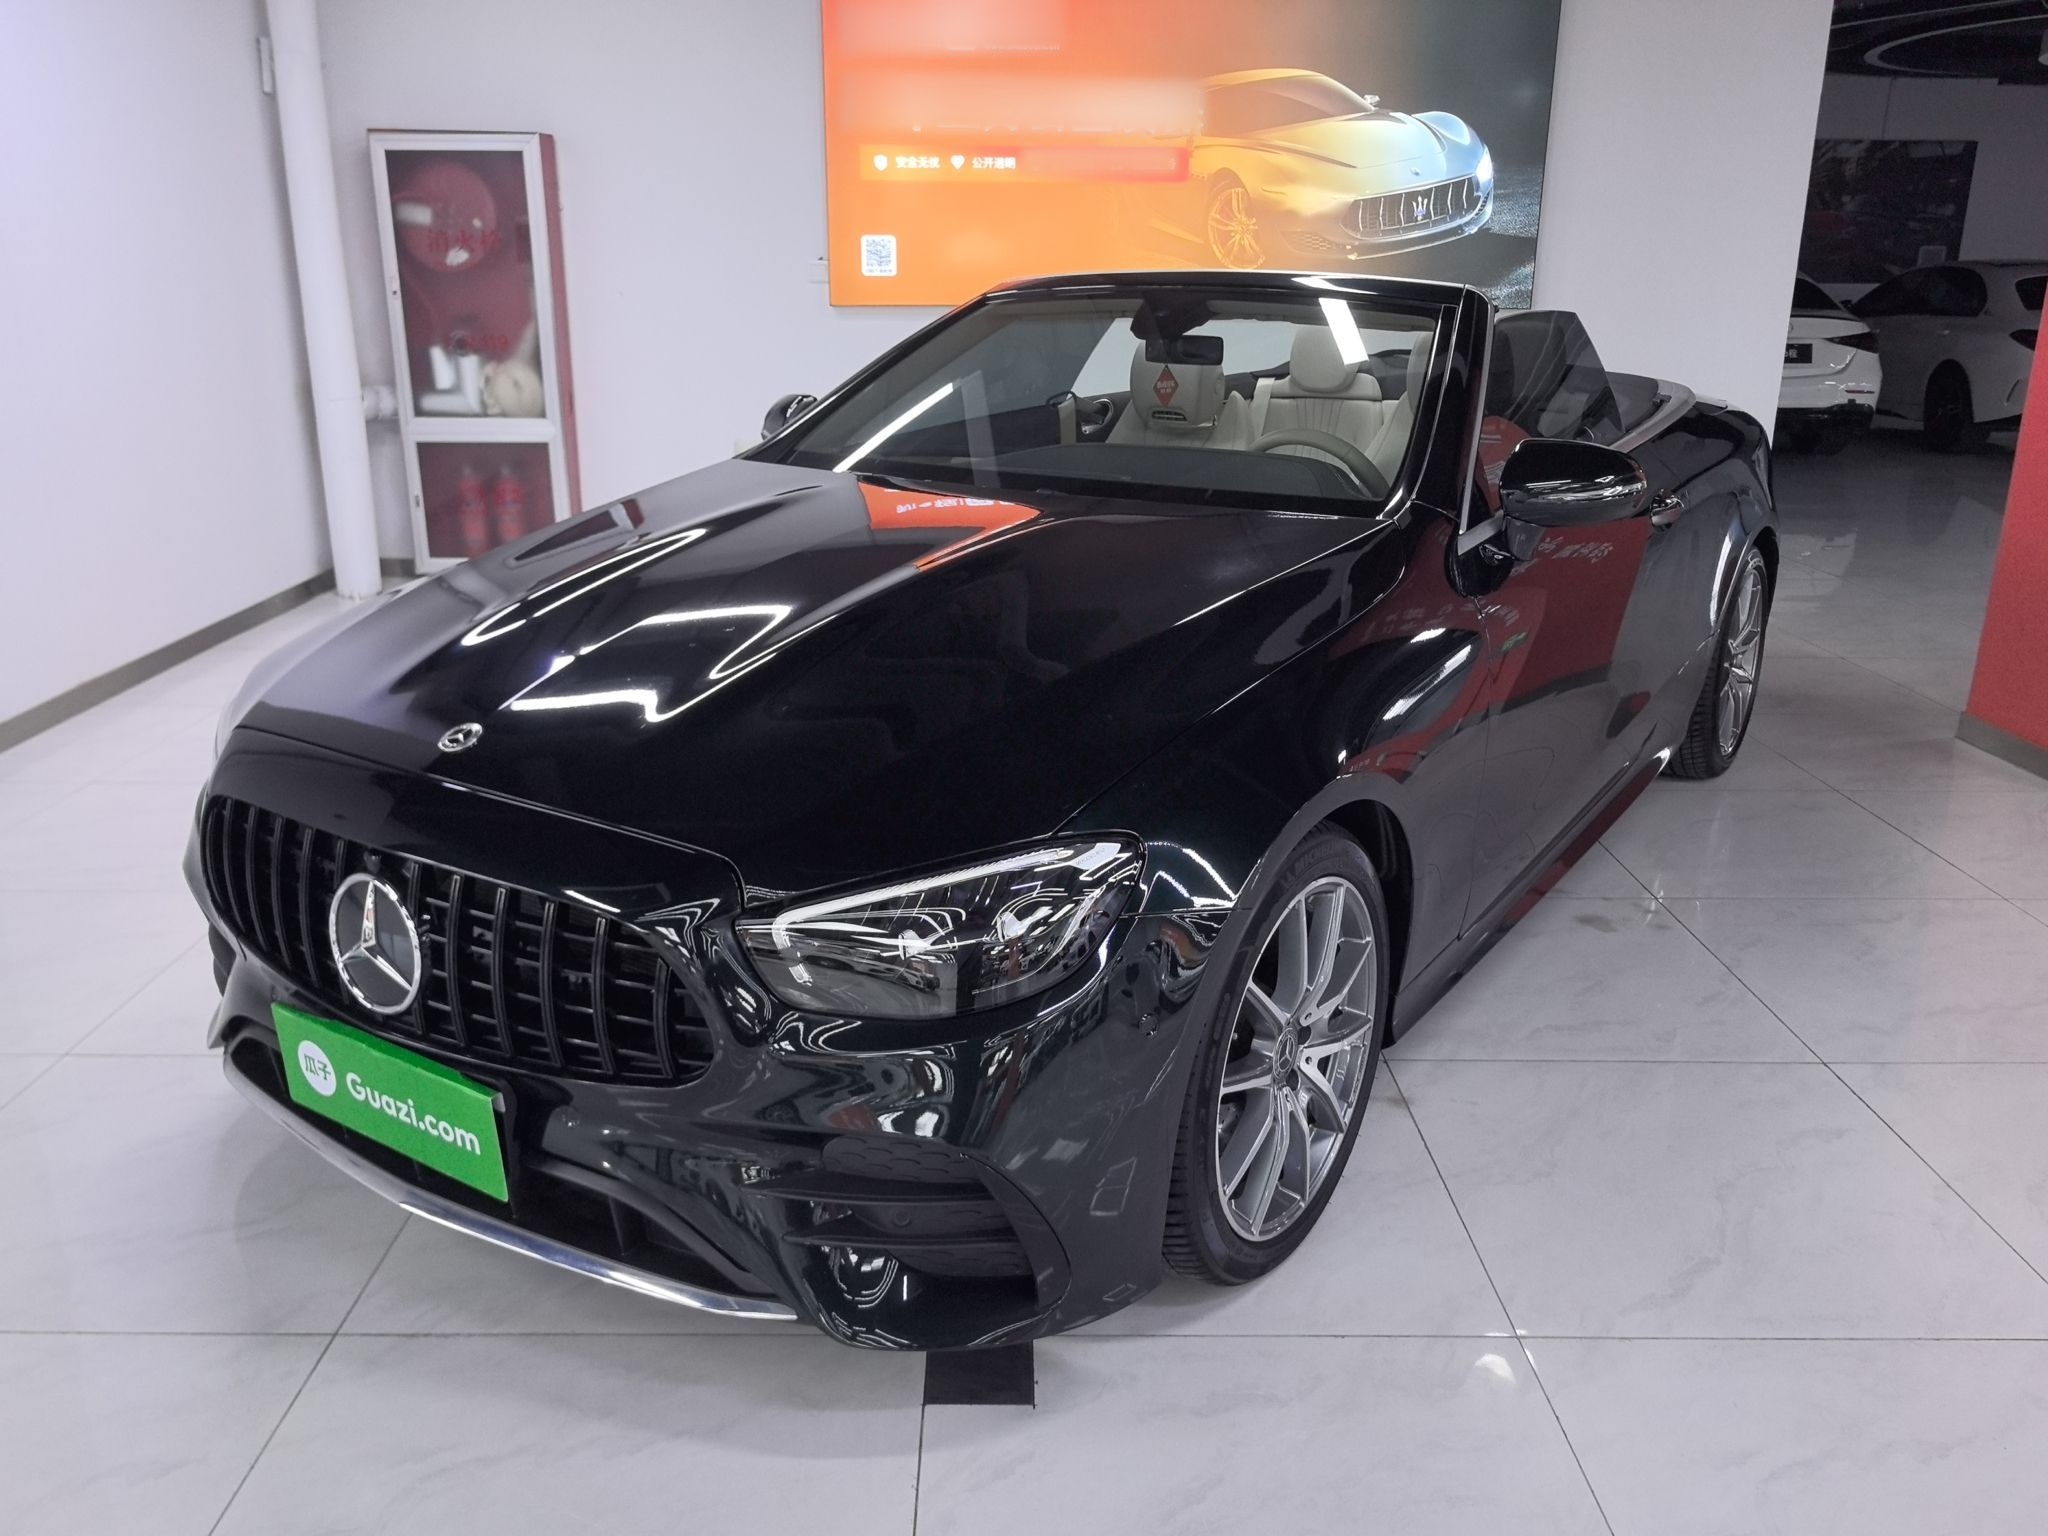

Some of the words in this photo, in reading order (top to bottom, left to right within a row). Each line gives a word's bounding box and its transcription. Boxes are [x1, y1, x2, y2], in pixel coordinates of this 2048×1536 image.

[971, 157, 1016, 170] 公开透明
[303, 1053, 332, 1081] 瓜子
[345, 1071, 481, 1156] Guazi.com
